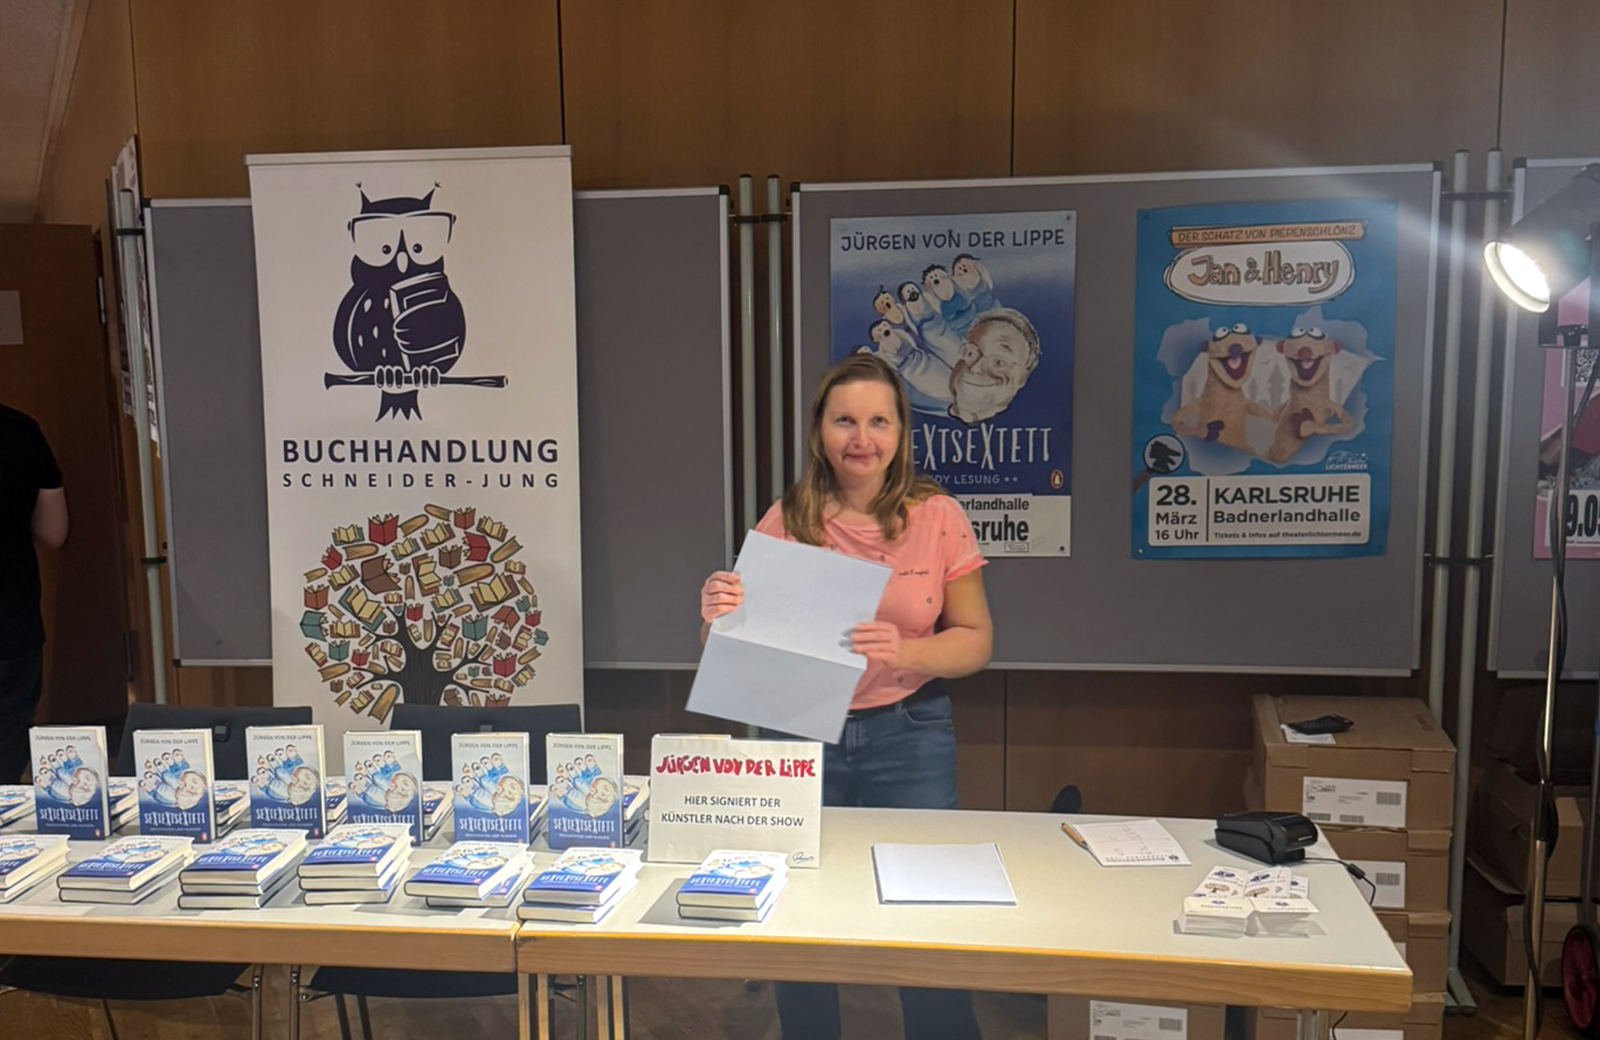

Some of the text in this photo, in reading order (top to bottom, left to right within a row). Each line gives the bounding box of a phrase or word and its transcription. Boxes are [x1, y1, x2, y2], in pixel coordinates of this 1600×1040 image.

[841, 228, 1065, 251] JÜRGEN VON DER LIPPE
[1178, 232, 1199, 242] DER
[1201, 229, 1243, 242] SCHATZ
[1245, 228, 1266, 239] VON
[1187, 250, 1339, 294] Jan & Henry
[283, 439, 558, 463] BUCHHANDLUNG
[911, 422, 1052, 471] EXTSEXTETT
[283, 473, 558, 488] SCHNEIDER-JUNG
[954, 474, 1000, 485] LESUNG
[1156, 484, 1197, 506] 28.
[1214, 485, 1360, 505] KARLSRUHE
[959, 498, 1029, 511] erlandhalle
[1155, 512, 1197, 526] März
[1213, 508, 1361, 524] Badnerlandhalle
[971, 514, 1029, 542] sruhe
[1155, 529, 1199, 541] 16 Uhr
[1248, 531, 1267, 539] Infos
[745, 759, 776, 777] DER
[684, 795, 781, 808] HIER SIGNIERT DER
[661, 811, 804, 827] KÜNSTLER NACH DER SHOW
